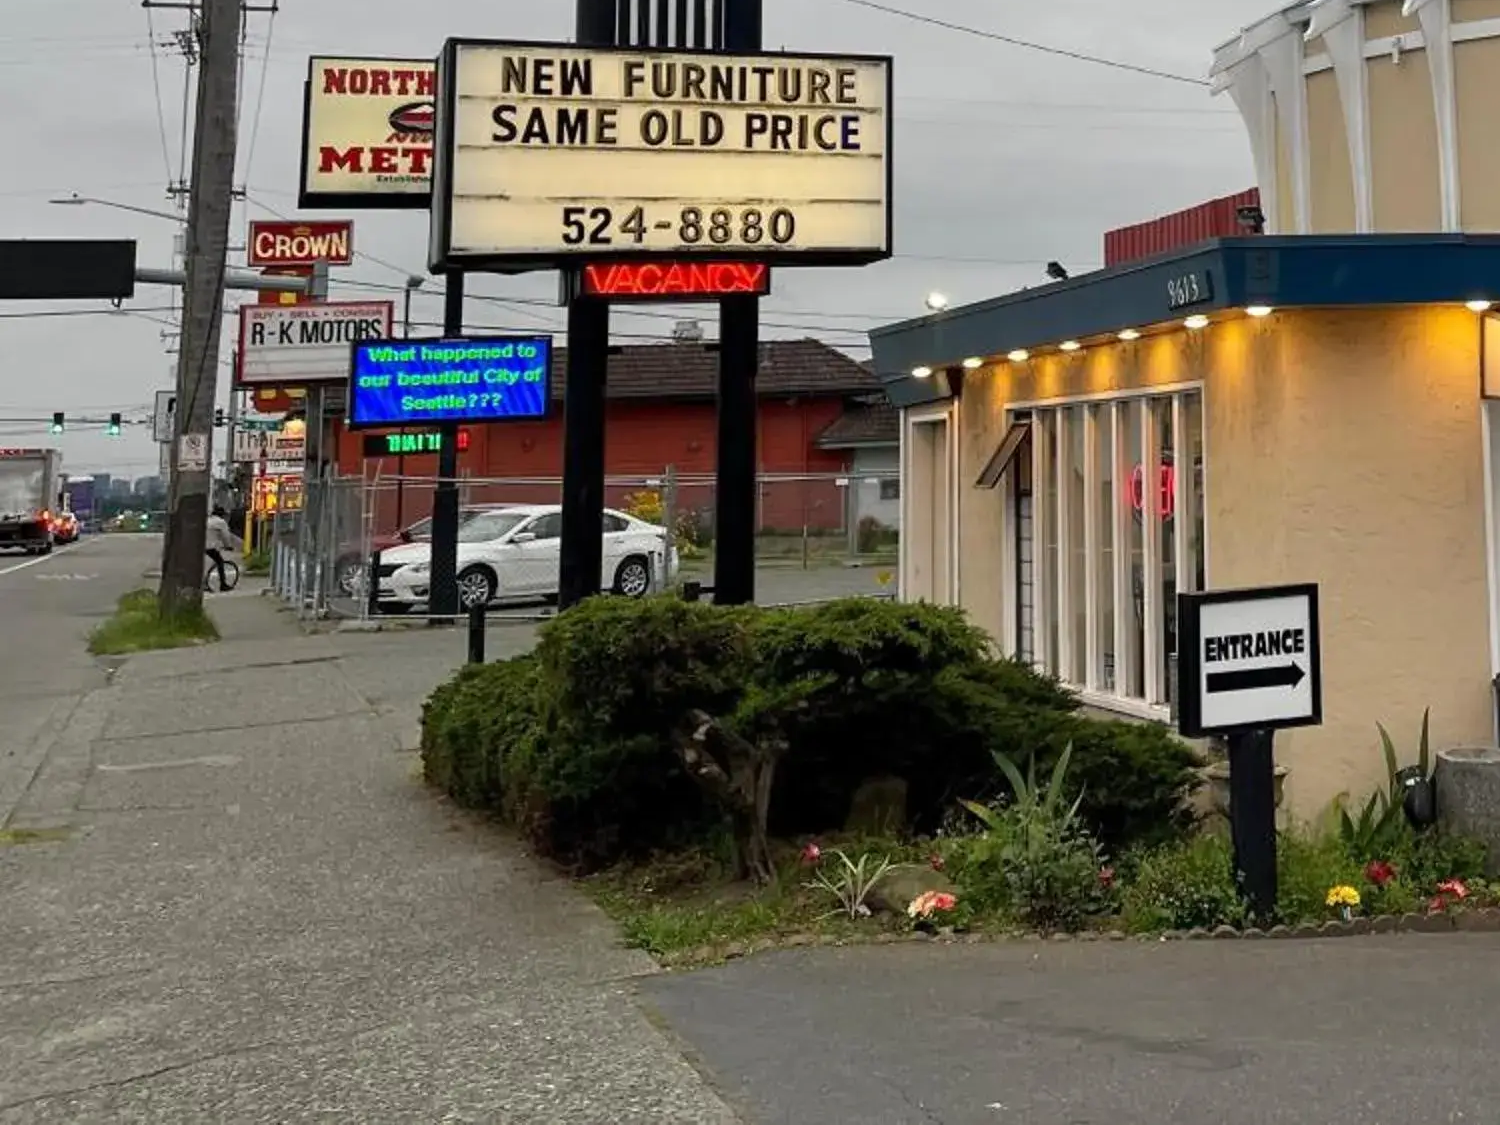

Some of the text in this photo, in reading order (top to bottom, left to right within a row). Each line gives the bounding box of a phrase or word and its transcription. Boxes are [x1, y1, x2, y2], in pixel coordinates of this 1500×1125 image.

[323, 68, 436, 96] NORTH
[501, 56, 858, 104] NEW FURNITURE
[491, 105, 862, 150] SAME OLD PRICE
[318, 146, 433, 174] MET
[561, 206, 797, 246] 524-8880
[255, 230, 348, 259] CROWN
[584, 263, 766, 295] VACANCY
[299, 318, 382, 344] MOTORS
[368, 344, 537, 363] What happened to
[359, 367, 544, 388] our beautiful City of
[401, 392, 503, 412] Seattle???
[1204, 628, 1305, 663] ENTRANCE
